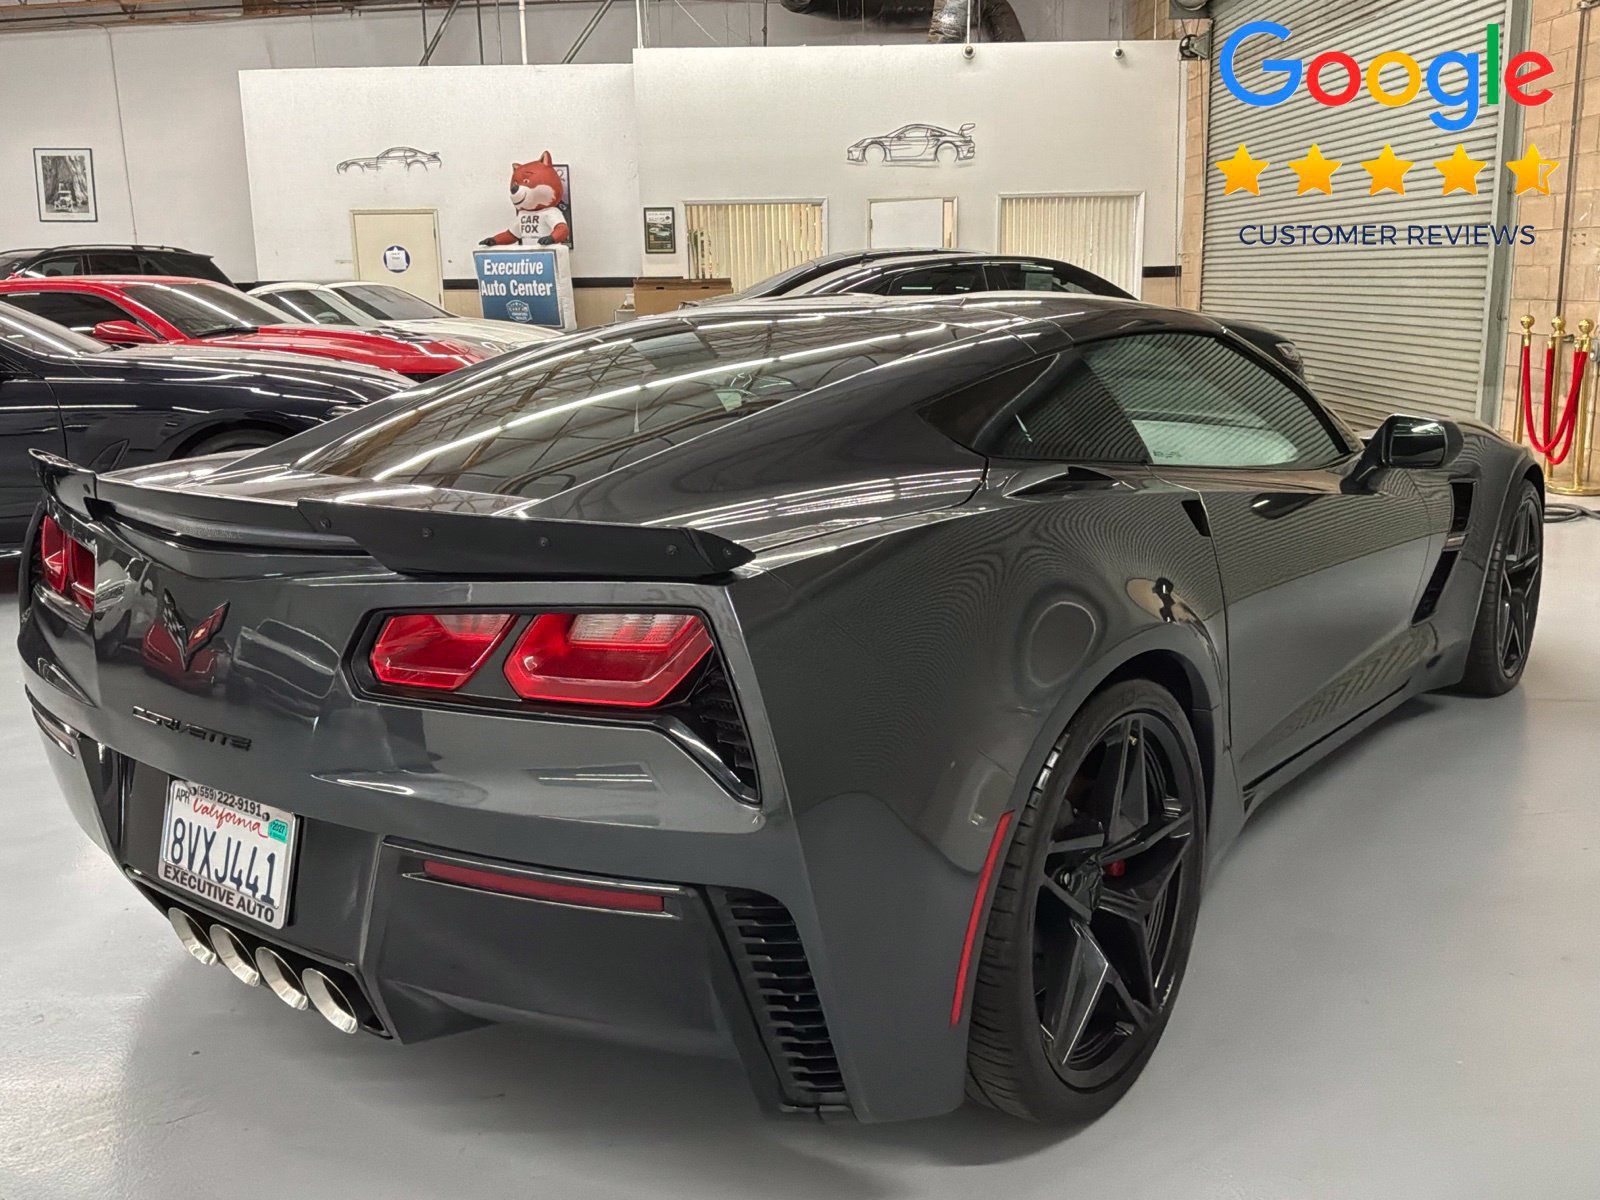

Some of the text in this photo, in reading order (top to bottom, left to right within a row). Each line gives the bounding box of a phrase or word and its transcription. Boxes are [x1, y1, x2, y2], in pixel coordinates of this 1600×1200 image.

[520, 215, 539, 224] CAR
[520, 225, 539, 233] FOX
[483, 259, 543, 276] Executive
[481, 279, 553, 297] Auto Center
[175, 787, 190, 804] APR
[217, 791, 262, 817] 222-9191
[193, 798, 268, 838] California
[170, 817, 276, 906] 8VXJ441
[164, 865, 275, 923] EXECUTIVE AUTO
